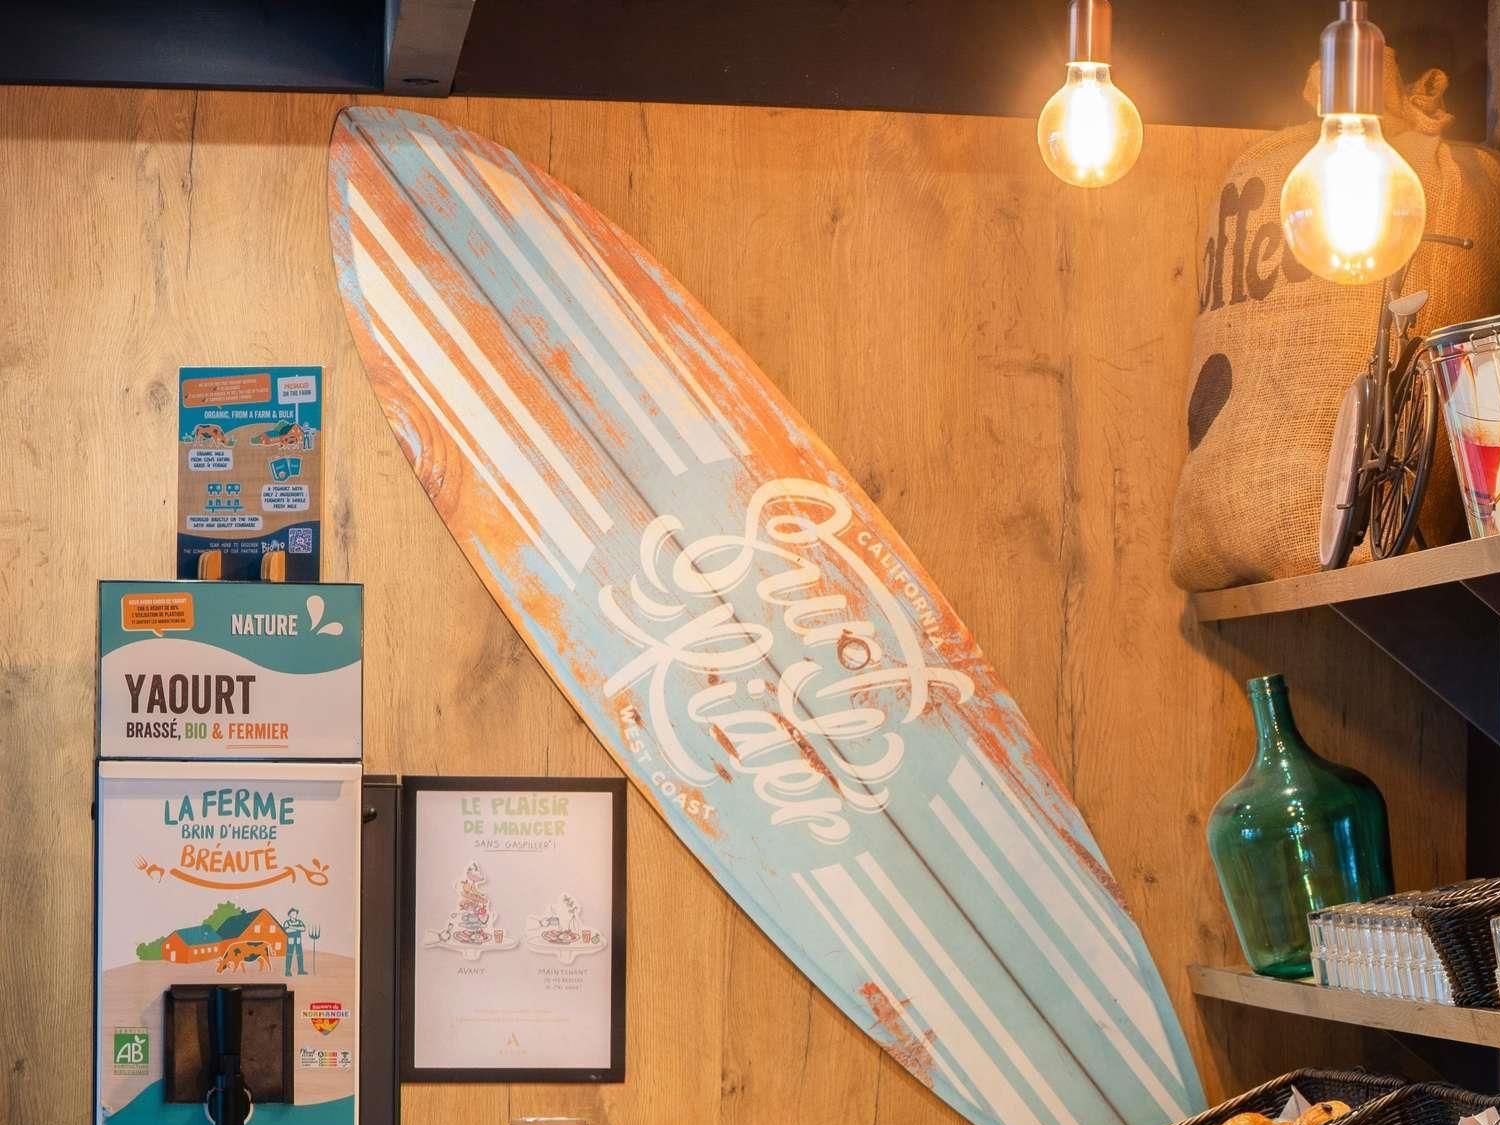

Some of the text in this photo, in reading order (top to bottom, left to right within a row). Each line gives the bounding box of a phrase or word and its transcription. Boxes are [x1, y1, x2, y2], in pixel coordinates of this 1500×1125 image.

[232, 410, 248, 418] FROM
[255, 410, 271, 418] FARM
[278, 410, 294, 418] BULK
[857, 531, 945, 651] CALIFORNIA
[231, 614, 297, 636] NATURE
[125, 673, 256, 715] YAOURT
[126, 718, 289, 741] BRASSÉ, BIO & FERMIER
[619, 703, 717, 820] WEST COAST
[164, 788, 295, 826] LA FERME
[461, 797, 481, 816] LE
[181, 823, 277, 840] BRIN D'HERBE
[463, 820, 484, 834] DE
[180, 842, 278, 873] BRÉAUTÉ
[116, 1042, 144, 1063] AB
